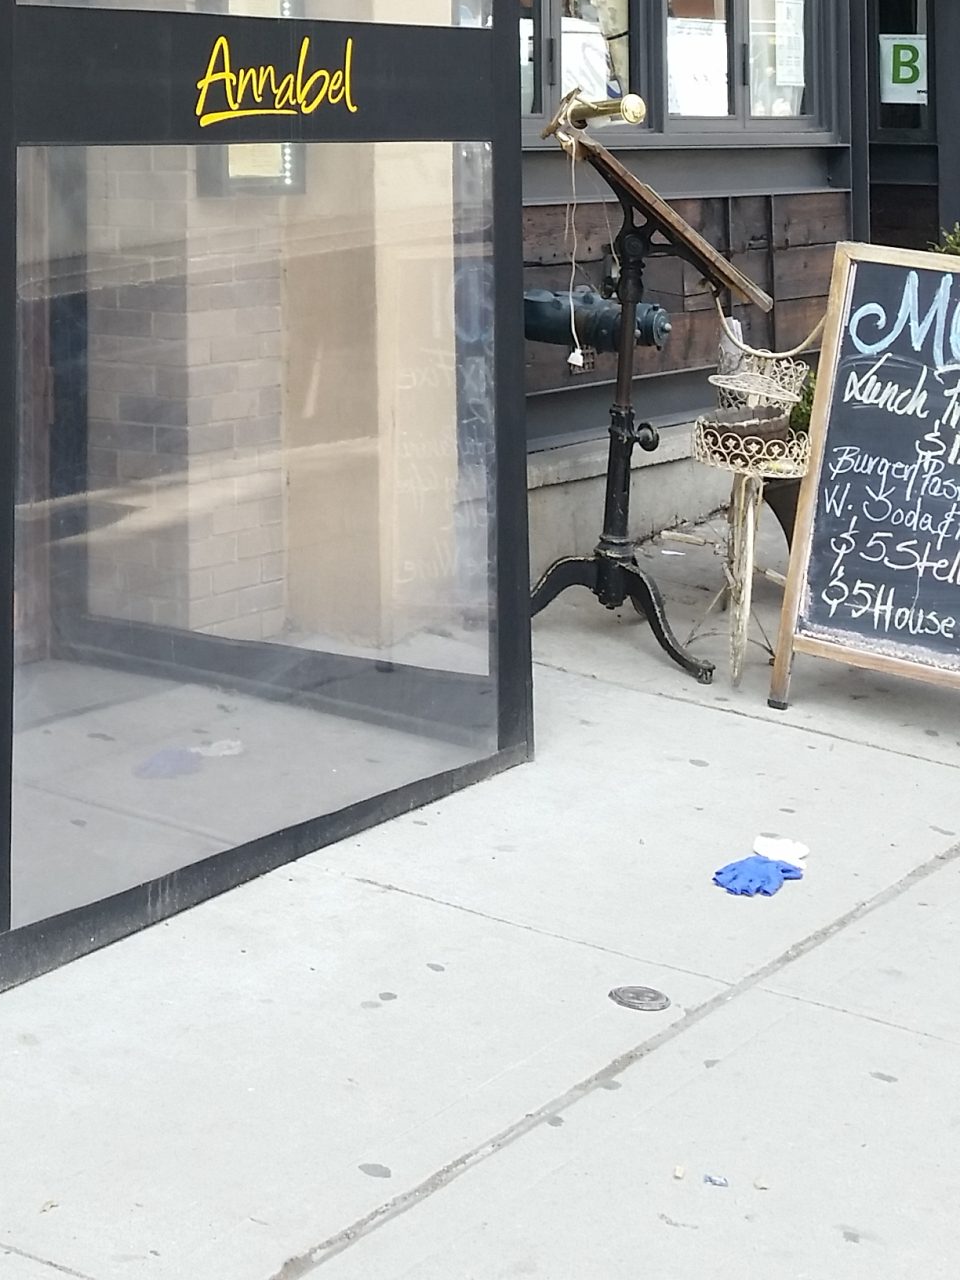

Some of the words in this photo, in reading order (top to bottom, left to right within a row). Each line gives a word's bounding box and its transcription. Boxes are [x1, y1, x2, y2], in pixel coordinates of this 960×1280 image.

[196, 36, 358, 127] Annabel
[892, 44, 920, 84] B
[843, 353, 929, 418] Lunch
[872, 583, 957, 639] House
